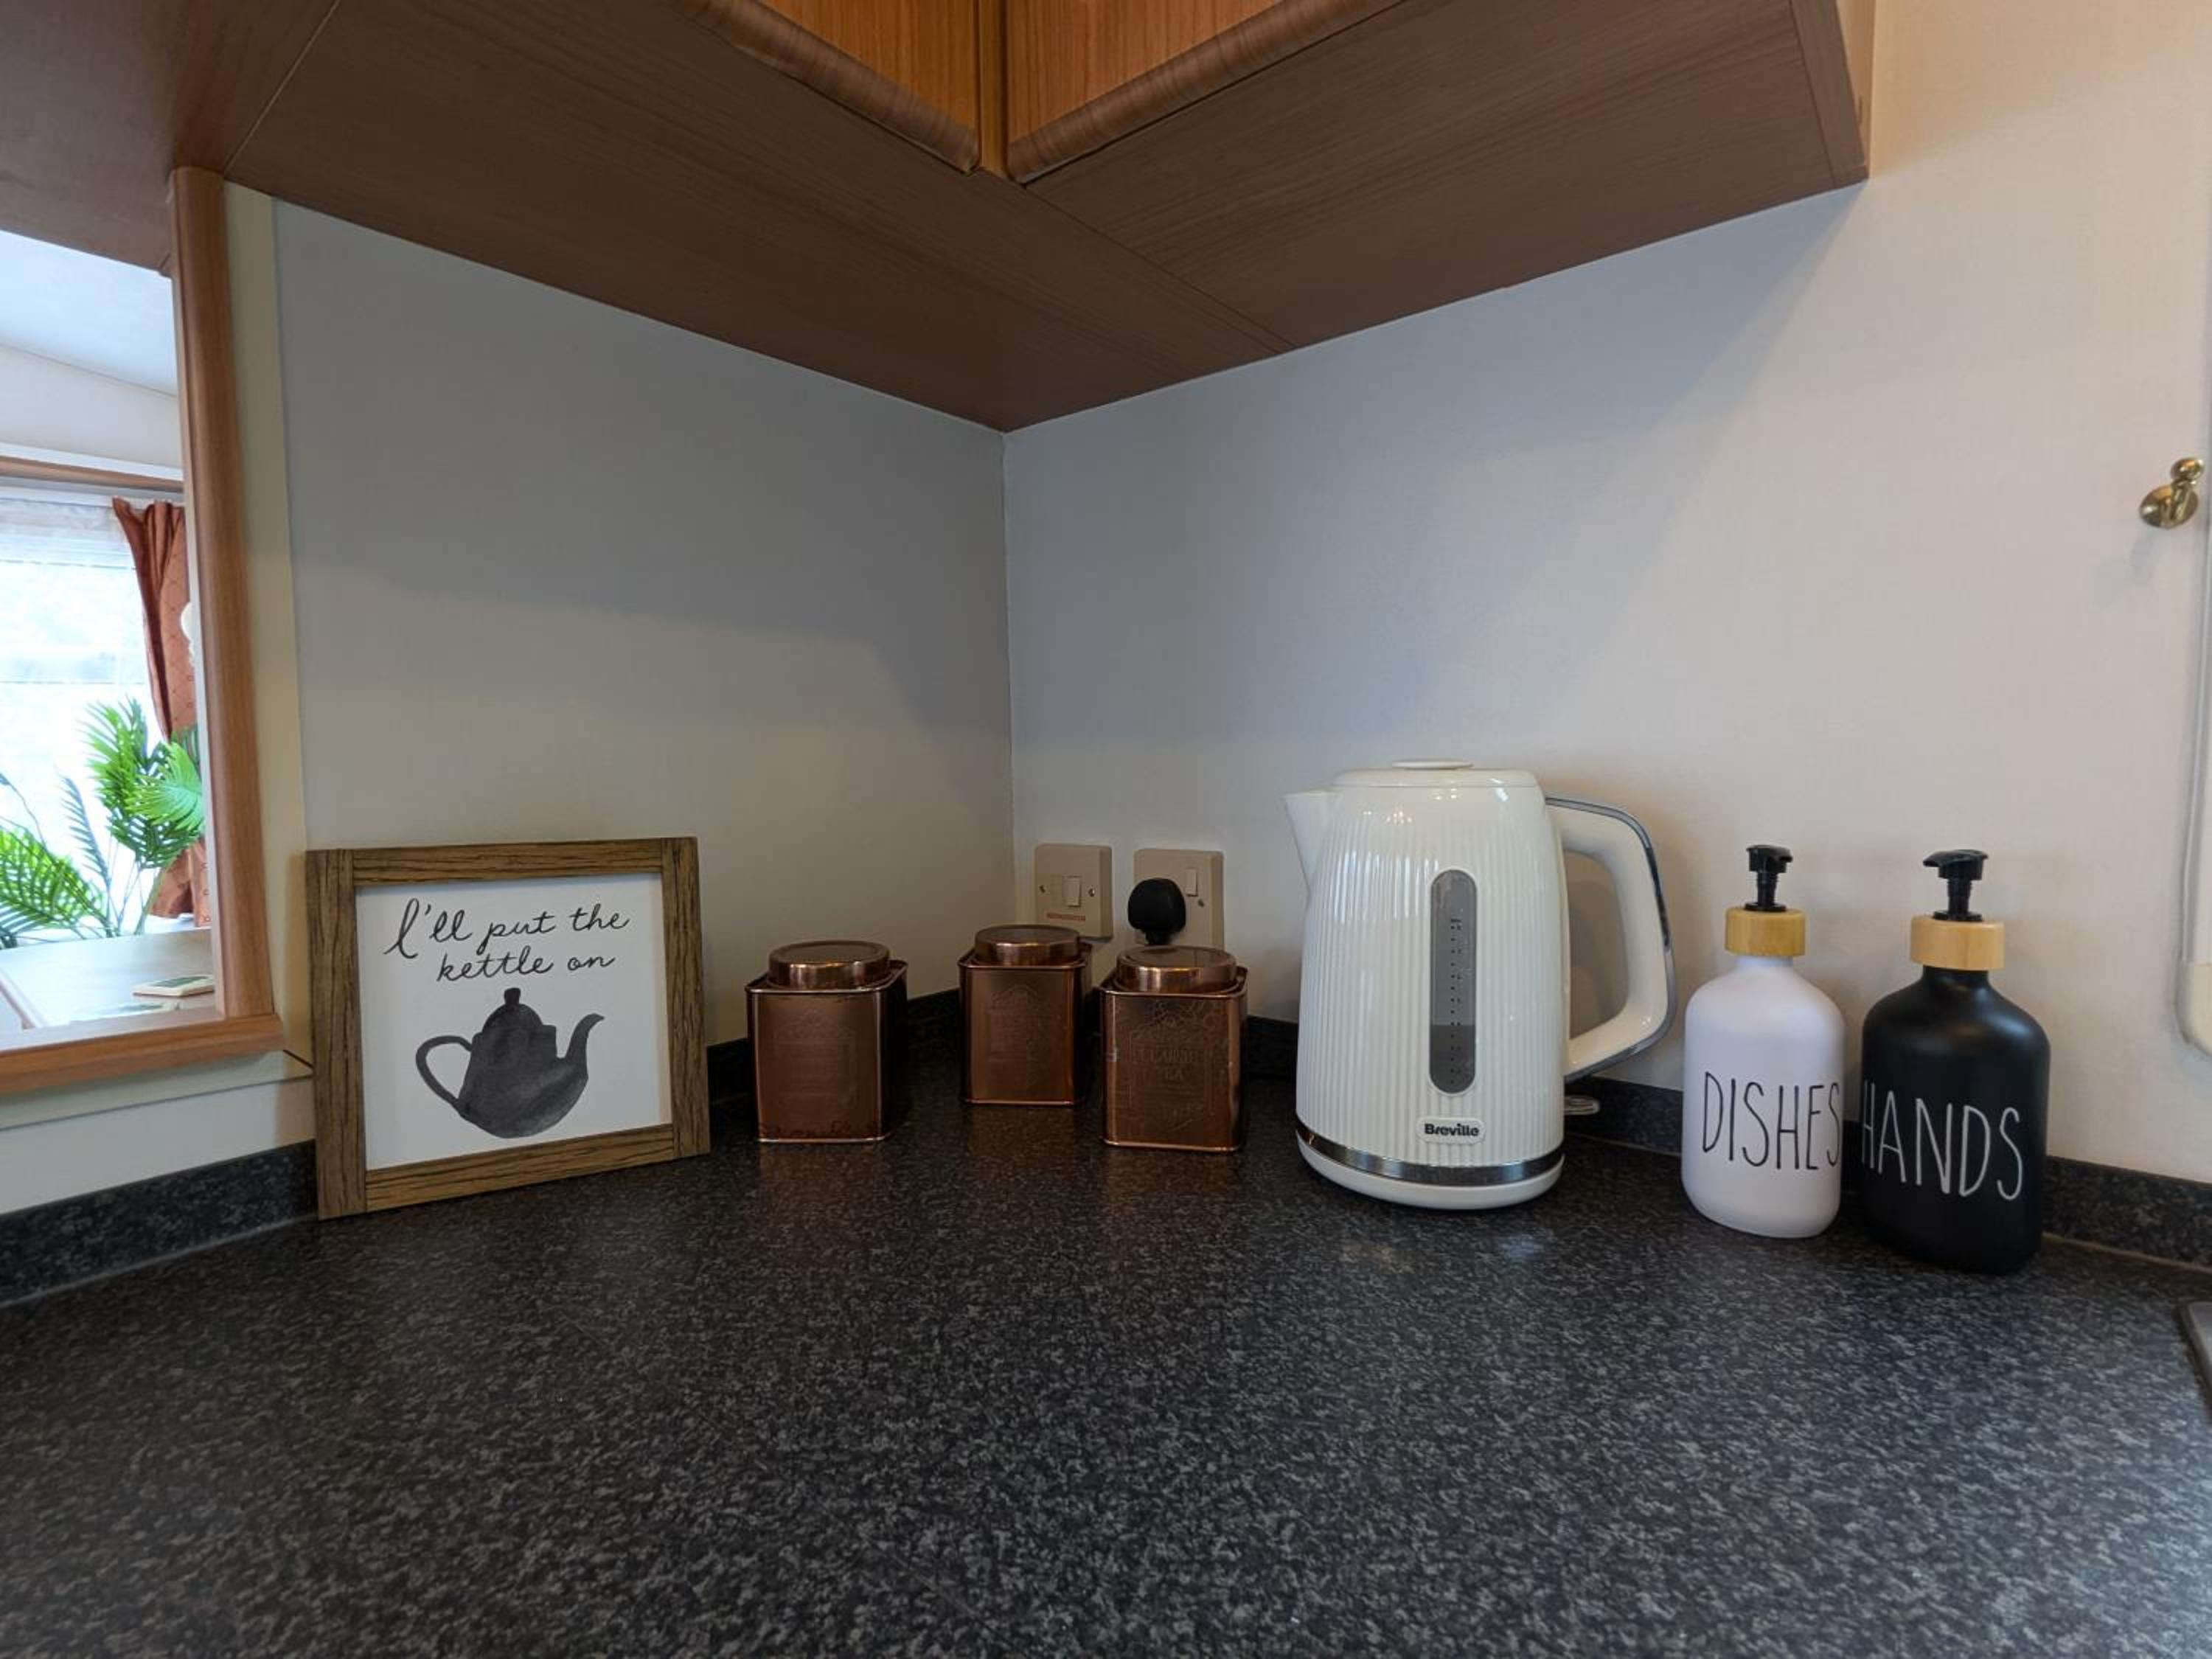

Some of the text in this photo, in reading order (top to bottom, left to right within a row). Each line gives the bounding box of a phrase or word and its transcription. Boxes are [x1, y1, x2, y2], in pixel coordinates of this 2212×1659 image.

[383, 897, 631, 959] I'll put the
[437, 945, 616, 982] kettle on
[1424, 1122, 1481, 1136] Breville
[1702, 1071, 1840, 1170] DISHES
[1862, 1079, 2023, 1200] HANDS
